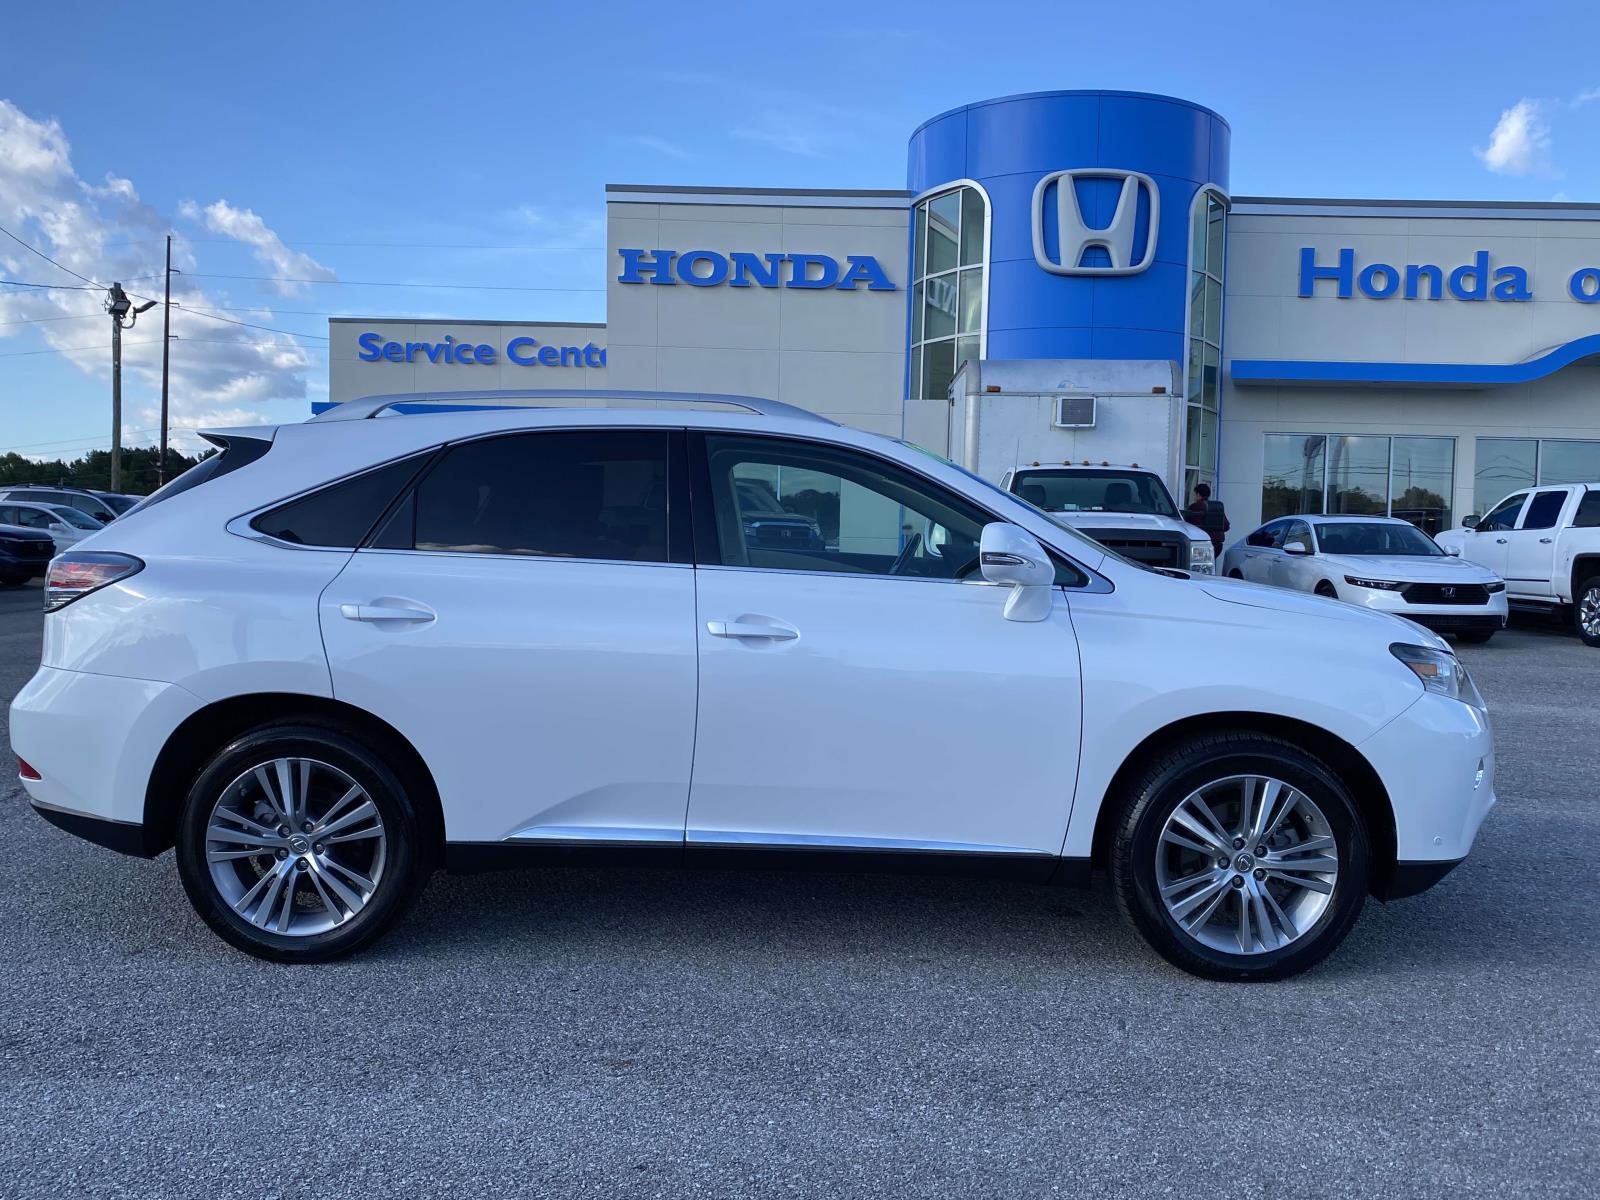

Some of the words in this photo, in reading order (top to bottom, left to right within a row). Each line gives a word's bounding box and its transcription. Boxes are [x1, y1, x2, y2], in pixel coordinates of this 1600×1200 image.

[617, 247, 897, 291] HONDA
[1298, 246, 1533, 302] Honda
[357, 331, 497, 366] Service
